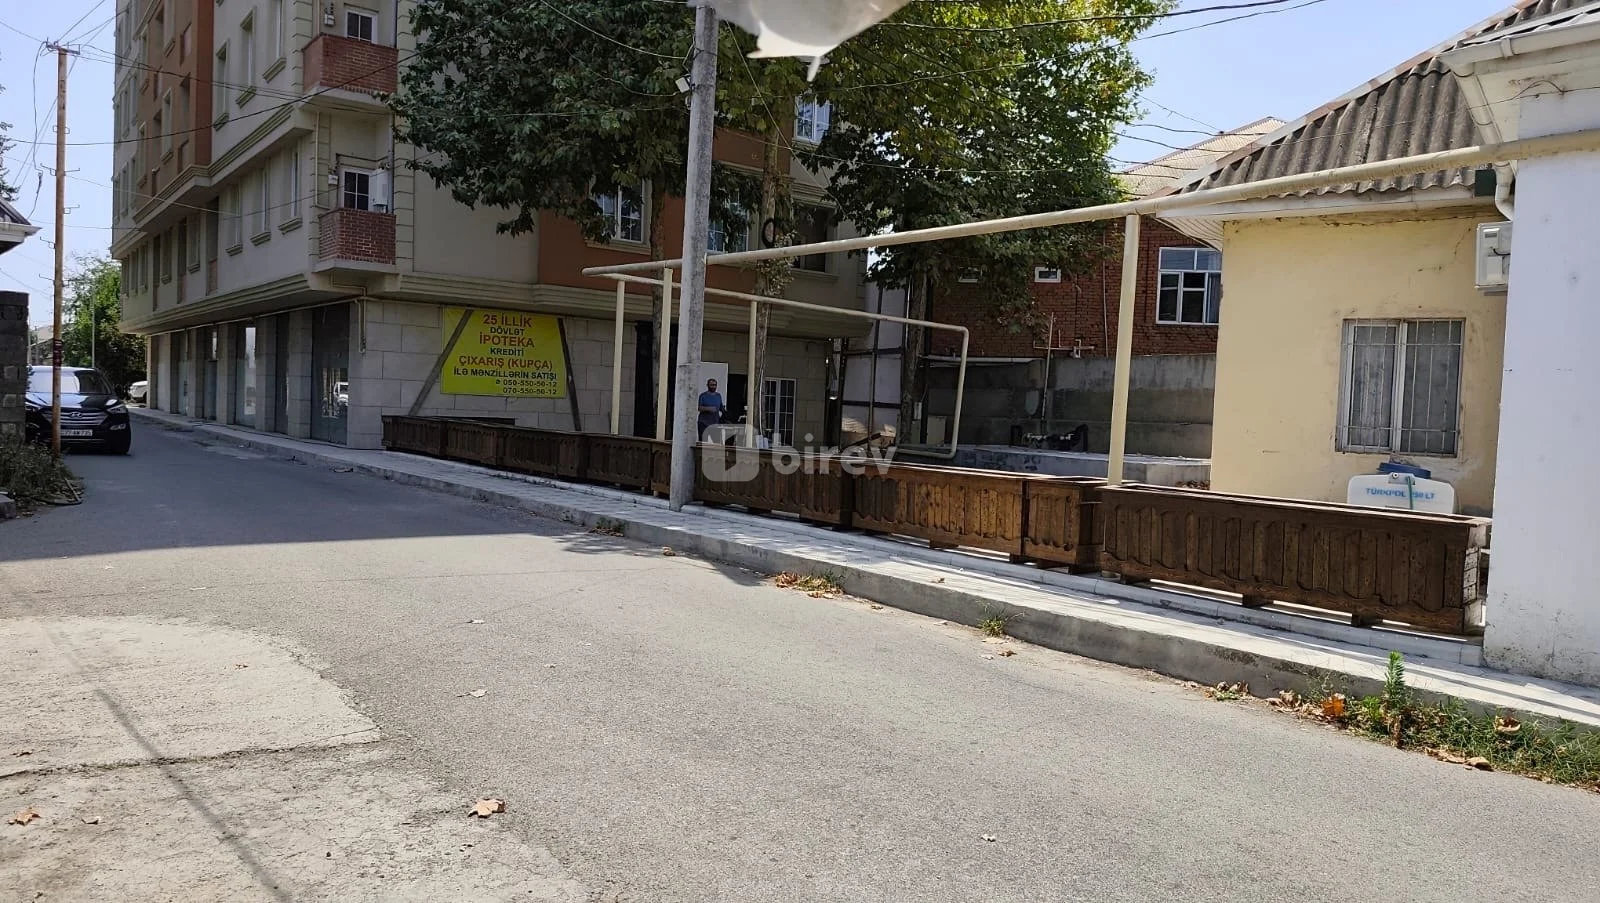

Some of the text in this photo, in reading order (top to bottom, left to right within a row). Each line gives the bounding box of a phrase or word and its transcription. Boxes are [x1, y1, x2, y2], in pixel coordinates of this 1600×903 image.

[483, 313, 532, 328] 25 İLLİK
[490, 326, 525, 336] DÖVLƏT
[479, 332, 535, 348] İPOTEKA
[490, 347, 524, 357] KREDİTİ
[508, 359, 553, 371] (KUPÇA)
[453, 366, 557, 381] İLƏ MƏNZİLLƏRİN SATIŞI
